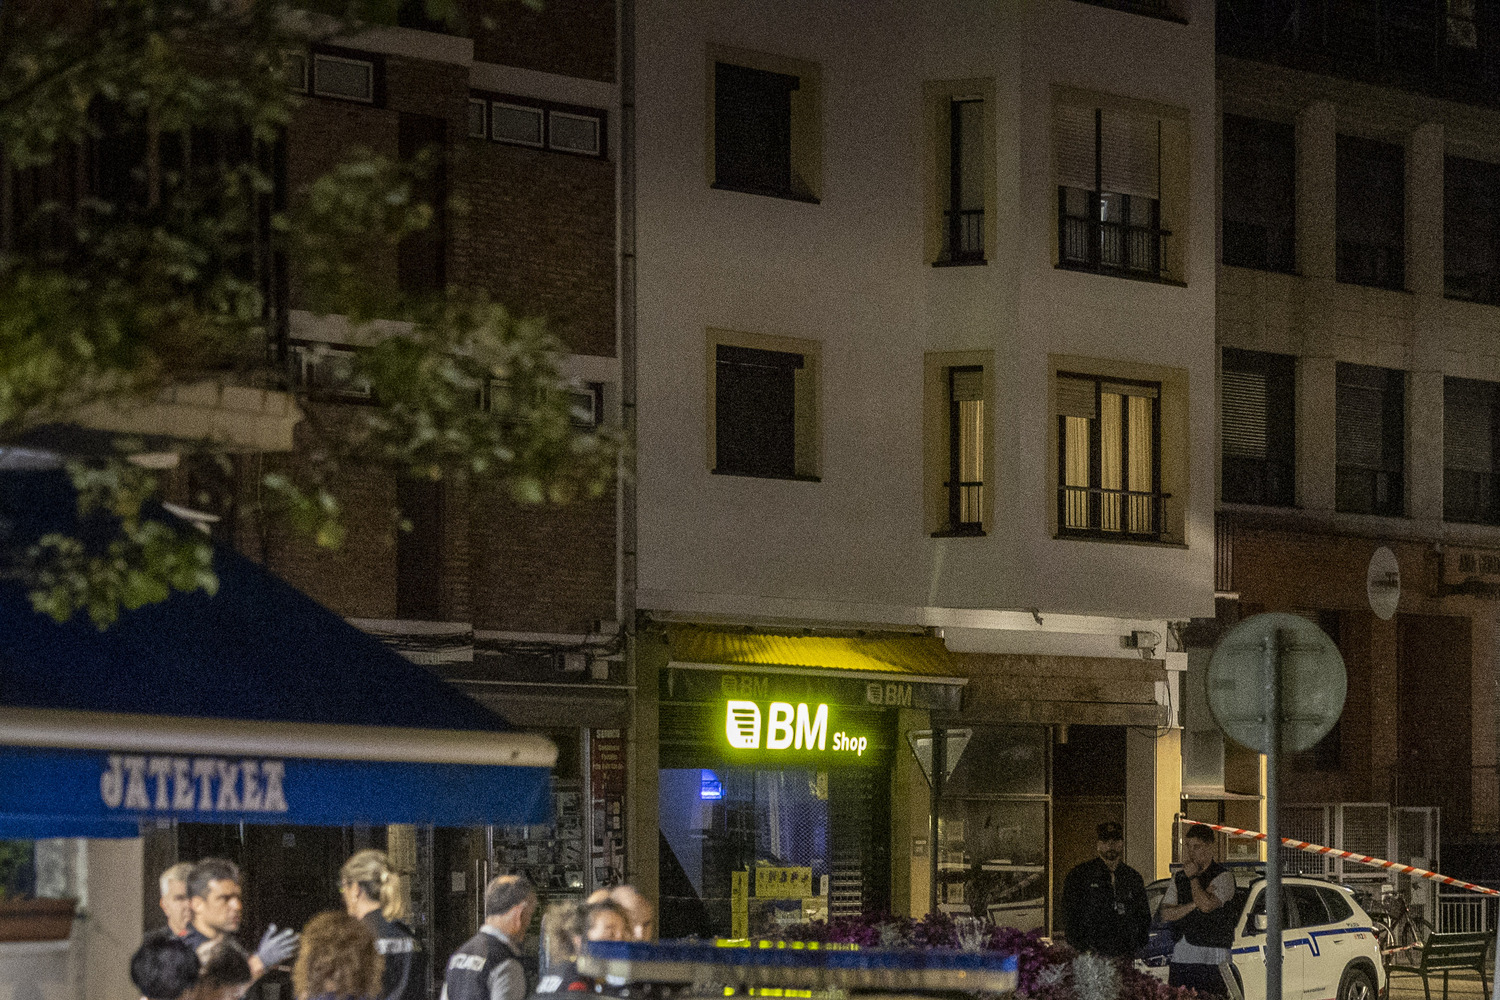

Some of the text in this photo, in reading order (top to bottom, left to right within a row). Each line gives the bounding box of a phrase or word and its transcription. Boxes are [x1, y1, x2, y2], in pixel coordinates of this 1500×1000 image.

[886, 683, 913, 706] BM
[766, 701, 867, 756] BM Shop
[101, 755, 288, 812] JATETXEA
